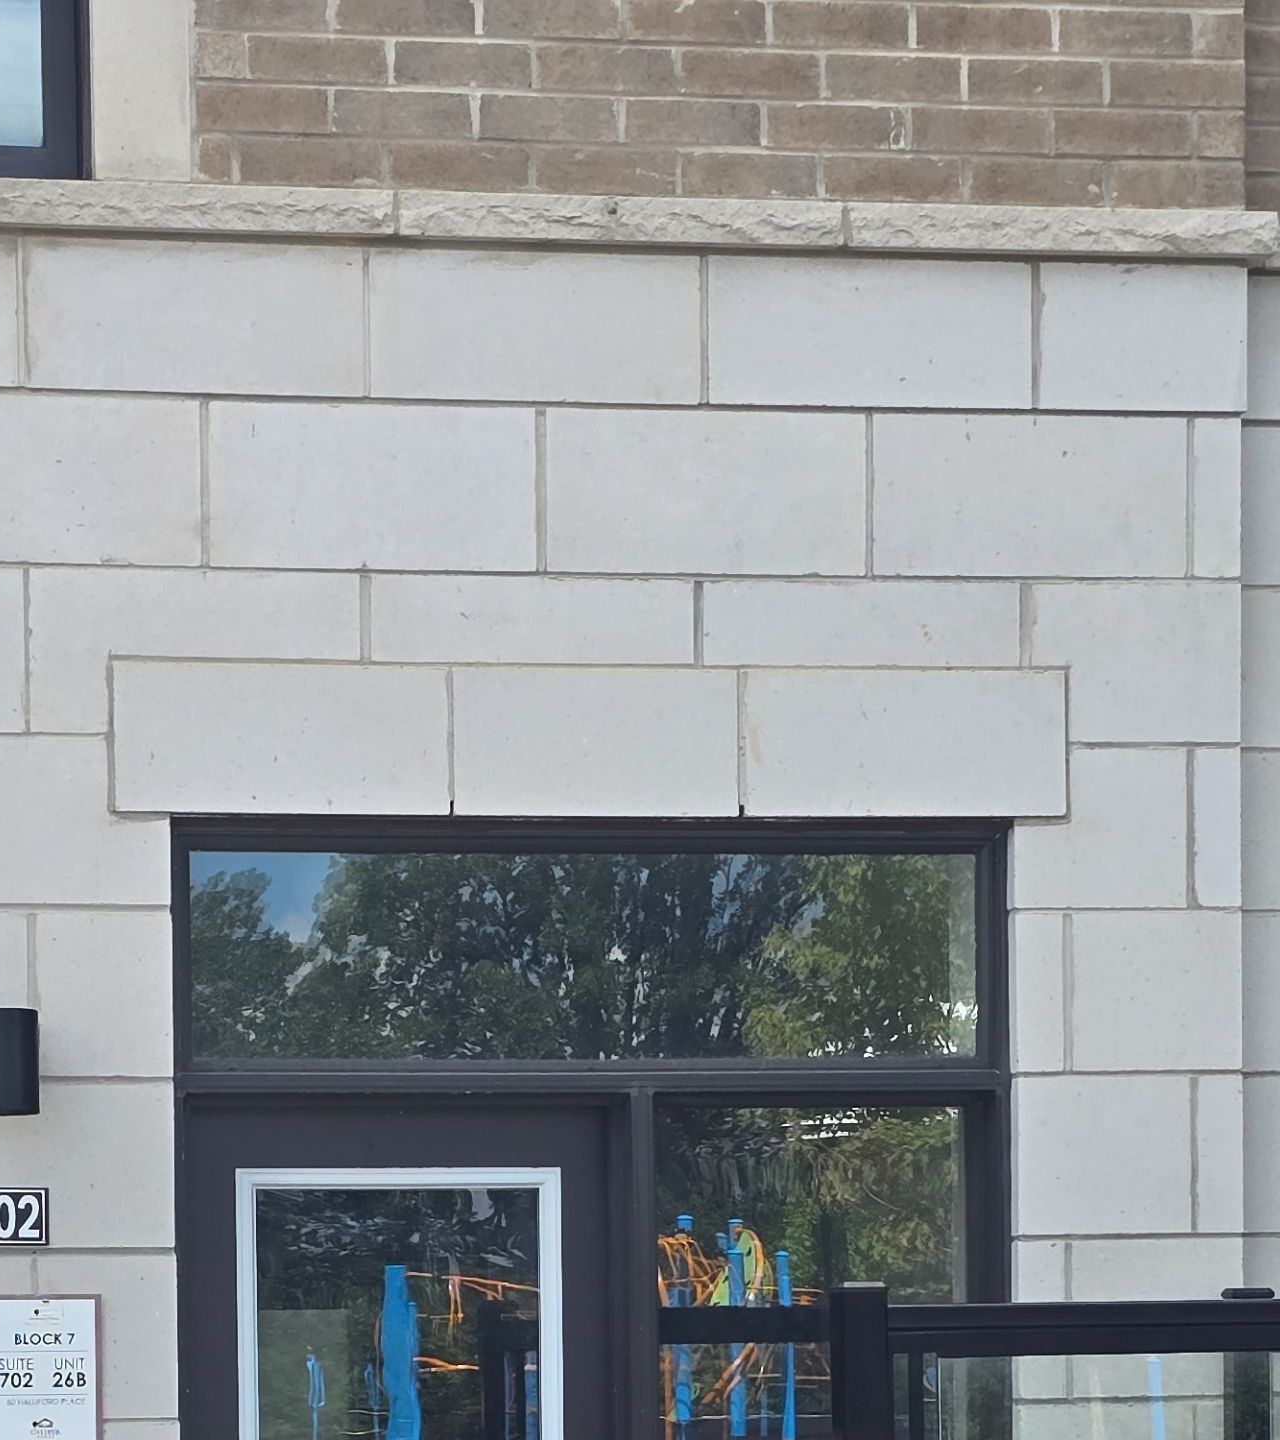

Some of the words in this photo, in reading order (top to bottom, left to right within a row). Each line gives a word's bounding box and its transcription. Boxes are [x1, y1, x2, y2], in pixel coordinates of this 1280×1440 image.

[14, 1332, 62, 1345] BLOCK
[67, 1332, 75, 1345] 7
[53, 1357, 85, 1370] UNIT
[0, 1373, 34, 1388] 702
[52, 1372, 87, 1388] 26B
